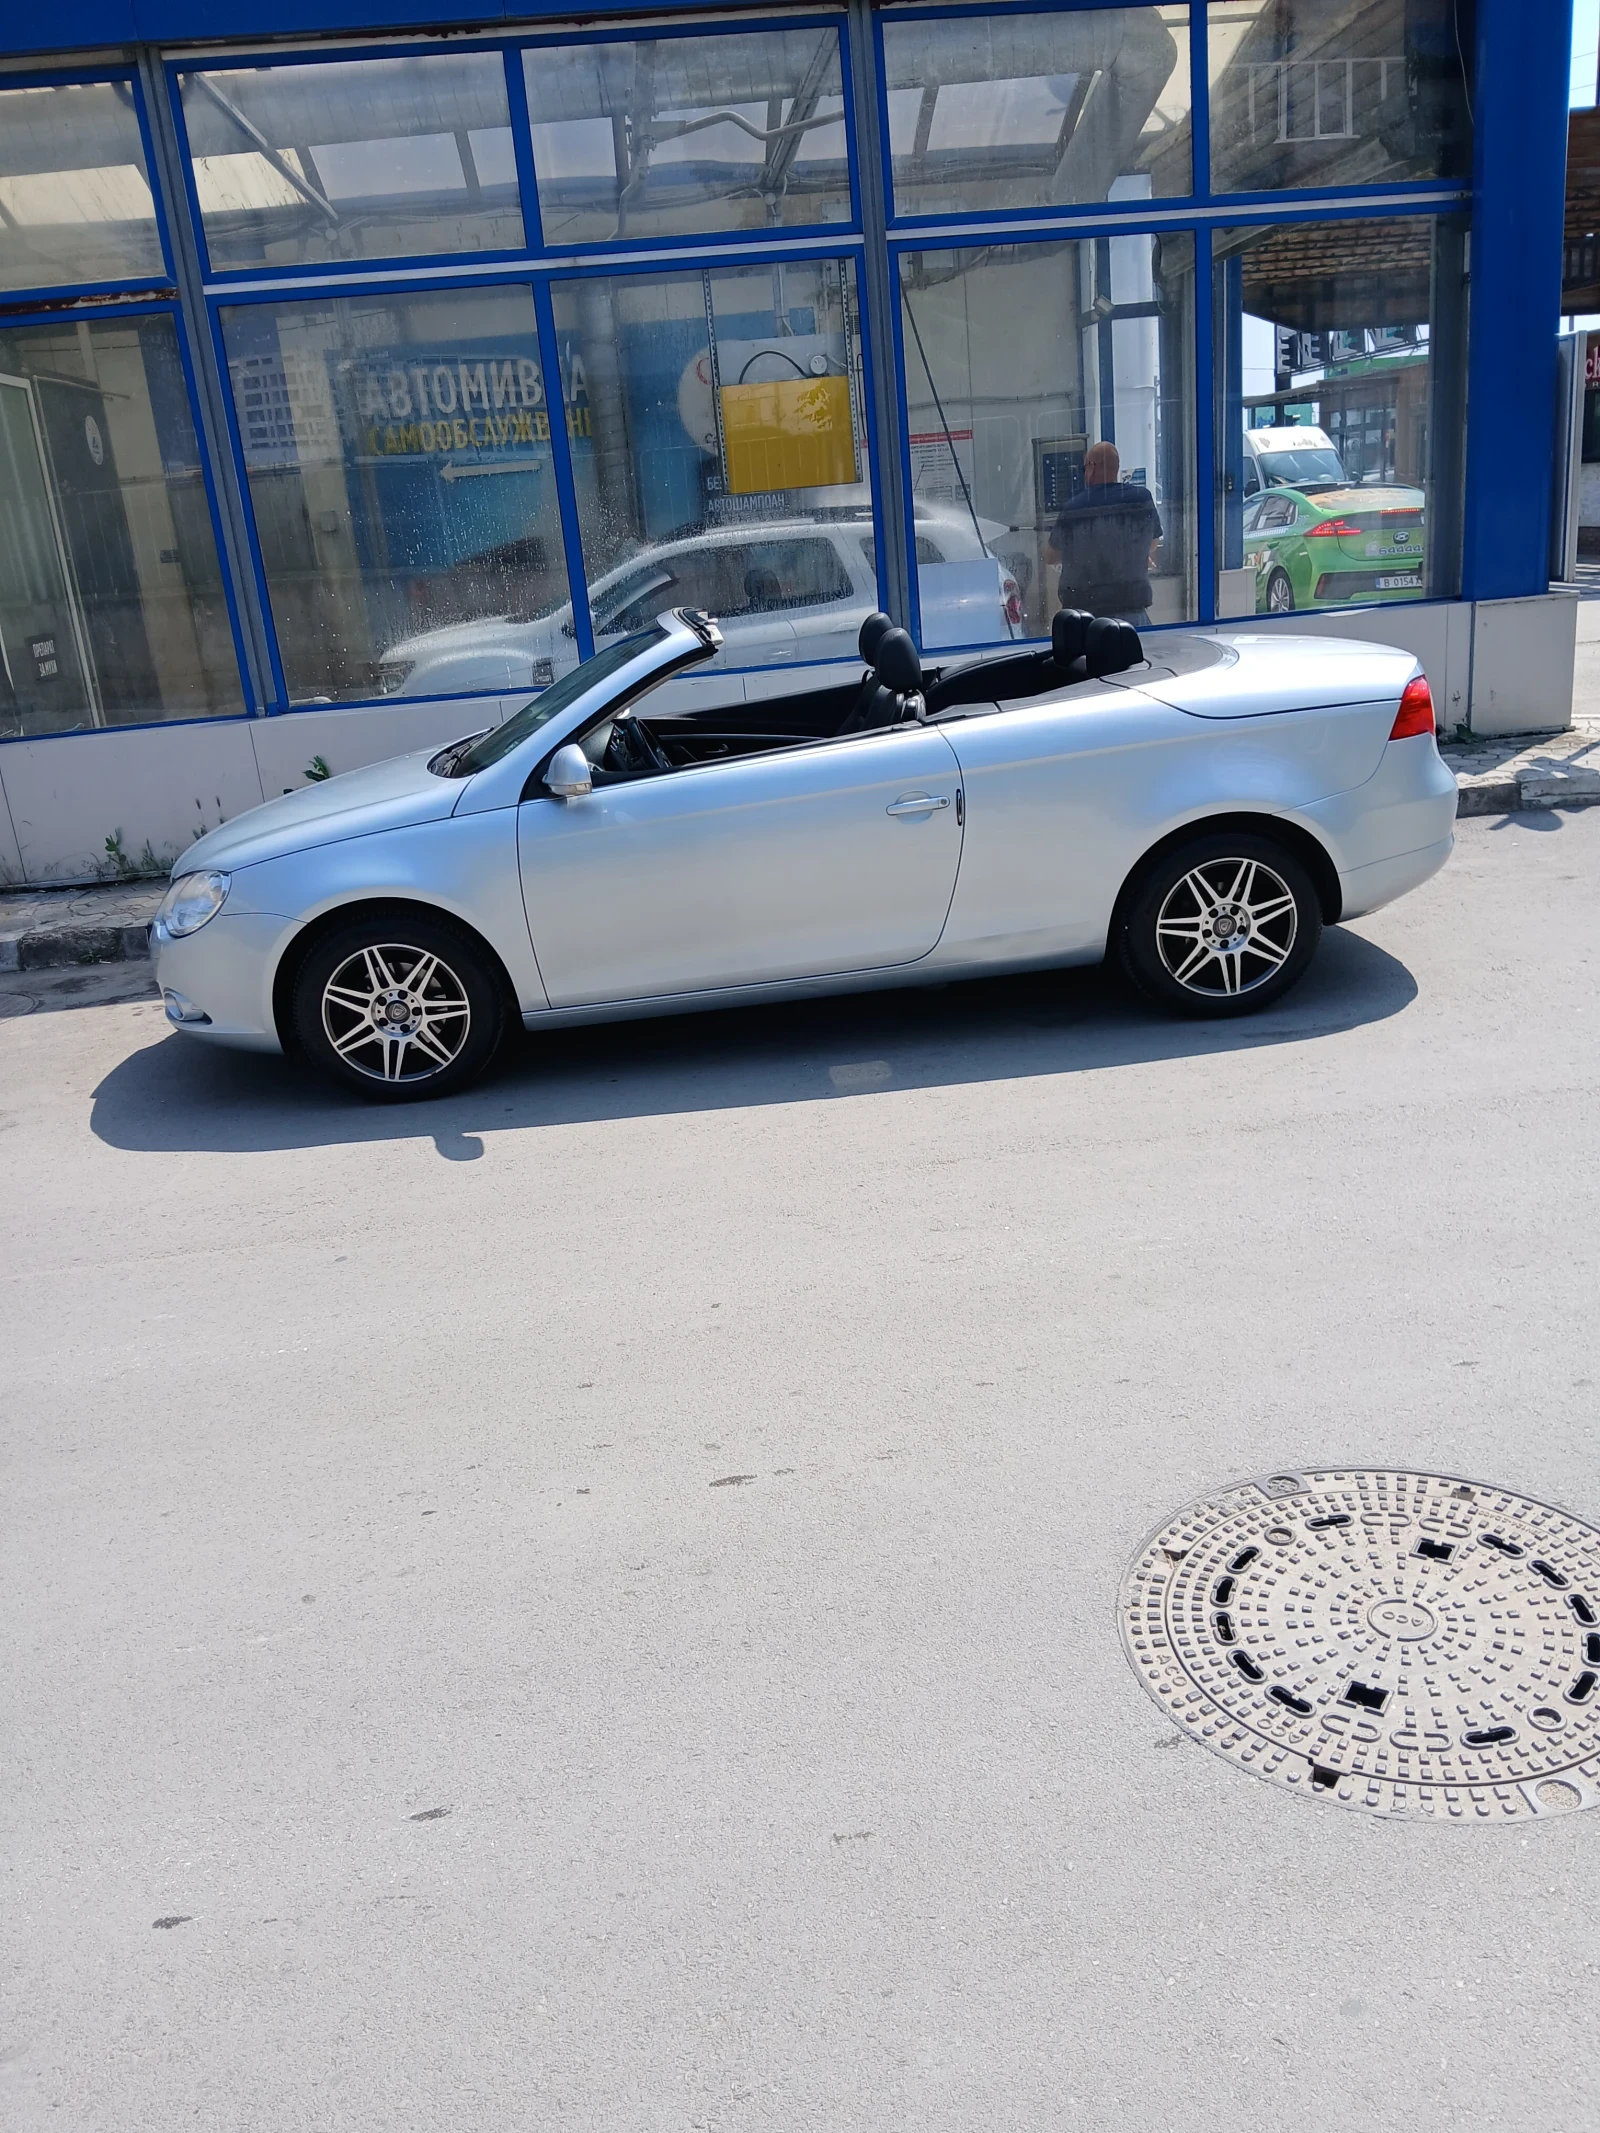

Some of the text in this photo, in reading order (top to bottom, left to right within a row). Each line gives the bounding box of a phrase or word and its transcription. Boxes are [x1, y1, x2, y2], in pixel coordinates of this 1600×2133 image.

[357, 354, 588, 419] АВТОМИВА
[708, 493, 785, 512] АВТОШАМПОАН
[1378, 545, 1424, 555] 64444
[1156, 1654, 1188, 1687] ACO
[1256, 1718, 1304, 1744] ACO
